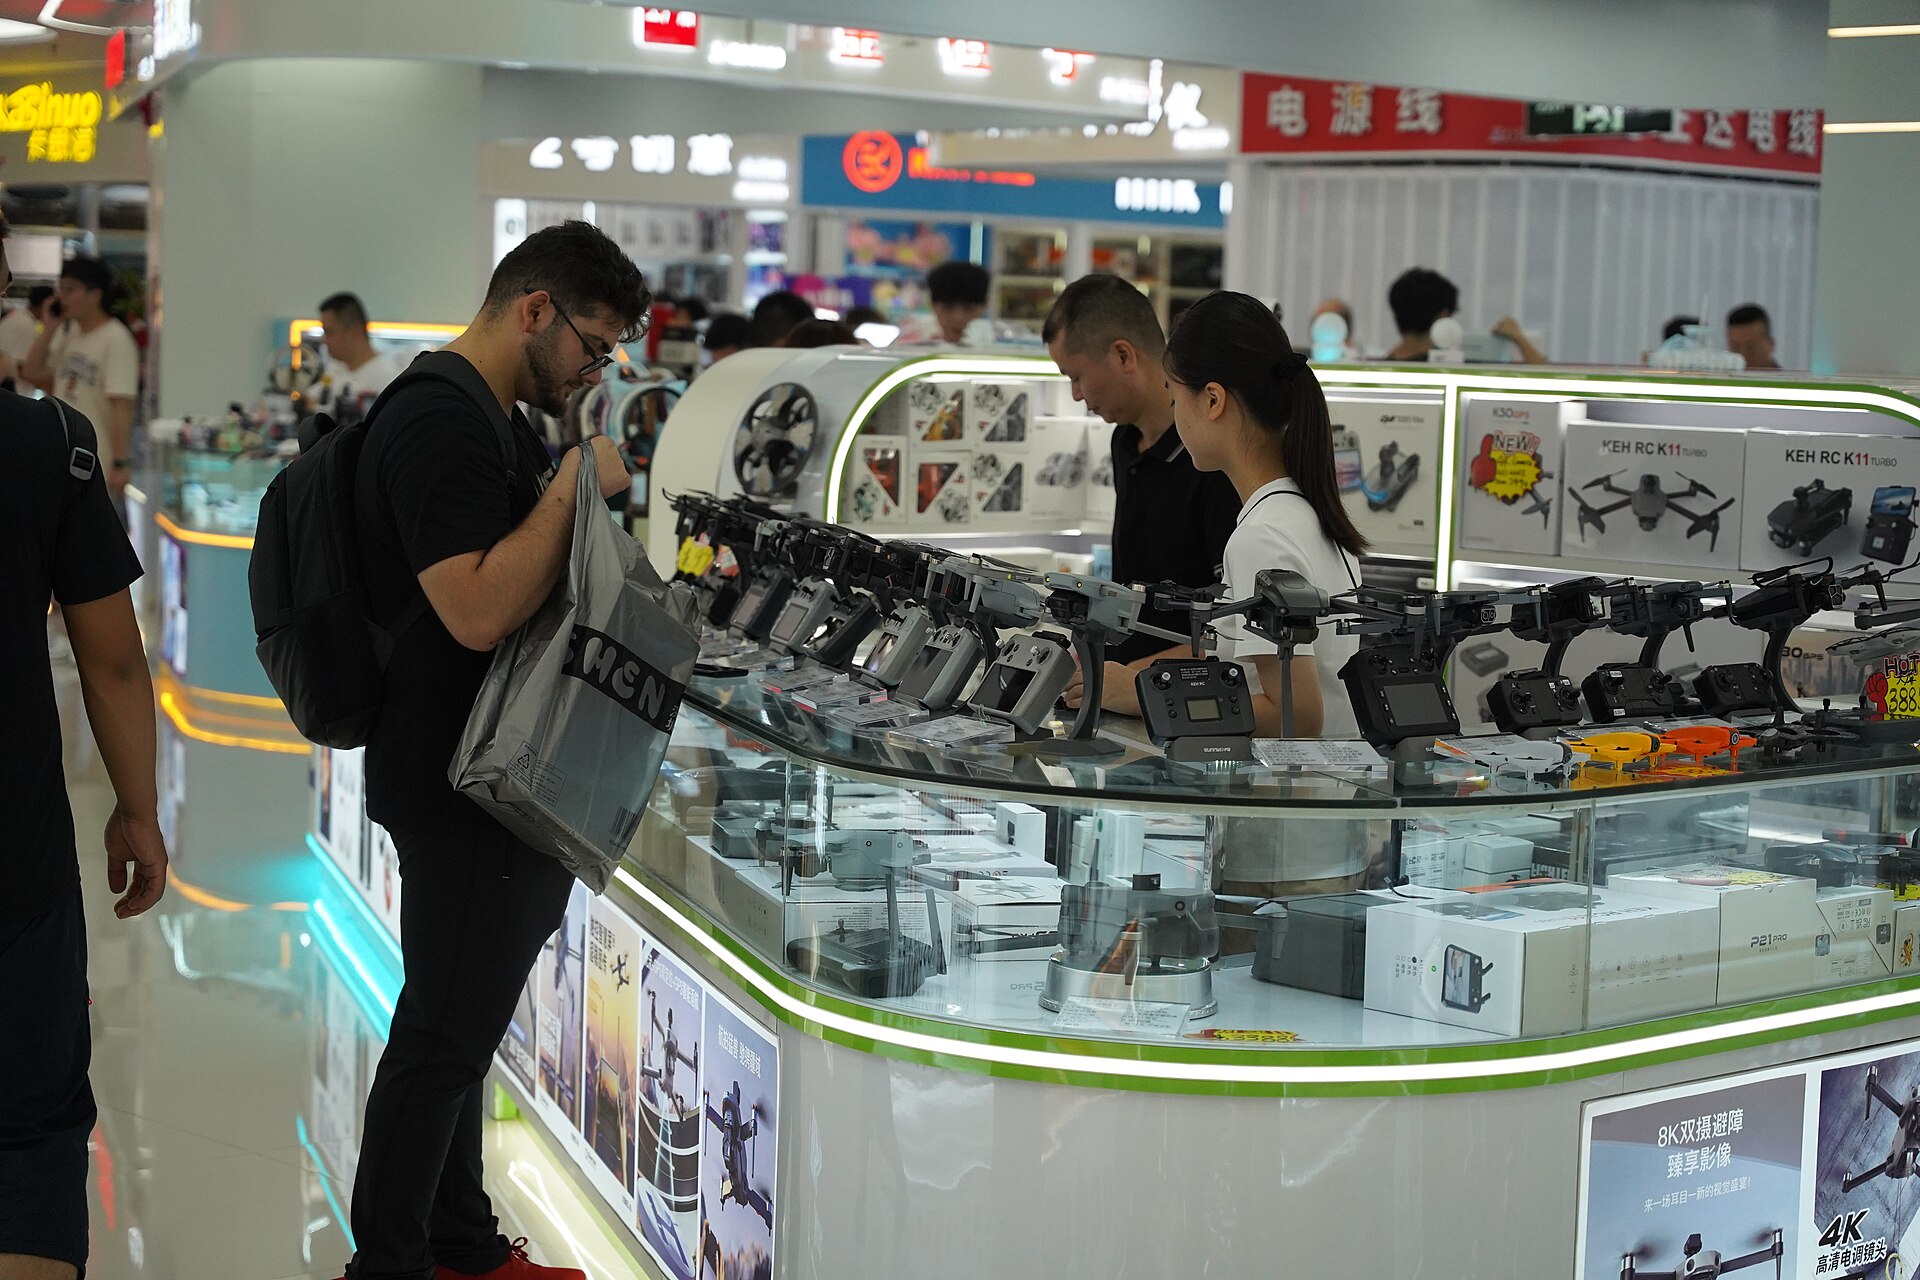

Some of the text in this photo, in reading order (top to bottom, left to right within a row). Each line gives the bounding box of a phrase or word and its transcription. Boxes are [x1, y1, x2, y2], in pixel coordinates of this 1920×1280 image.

[1267, 83, 1442, 137] 电源线
[1635, 441, 1654, 455] RC
[1657, 443, 1680, 456] K11
[1785, 449, 1897, 467] KEH RC K11 TURBO
[1750, 933, 1788, 948] P21 PRO
[1657, 1107, 1743, 1147] 8K双摄避障
[1667, 1142, 1731, 1178] 臻享影像
[1818, 1209, 1869, 1247] 4K
[1815, 1240, 1886, 1275] 高清电调镜头
